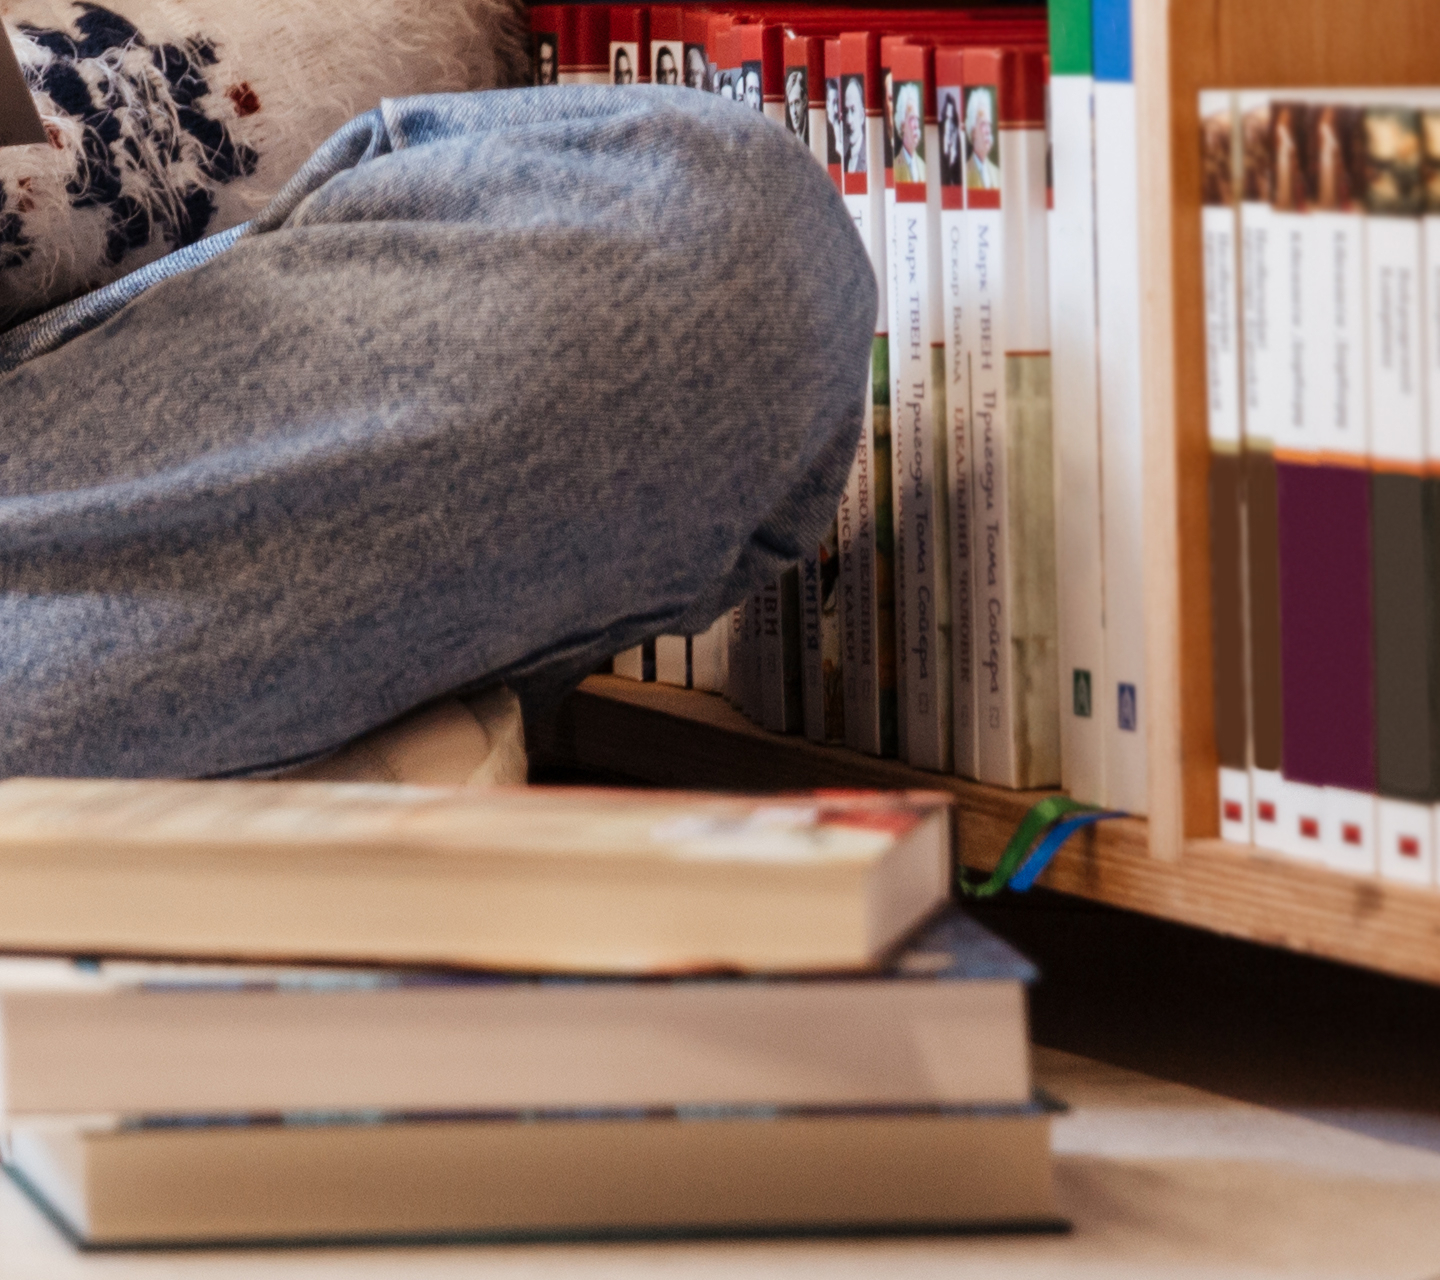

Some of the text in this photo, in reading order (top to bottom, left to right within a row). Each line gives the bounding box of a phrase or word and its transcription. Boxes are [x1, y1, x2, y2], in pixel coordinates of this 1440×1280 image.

[949, 225, 961, 298] Оскар
[905, 217, 932, 680] Марк ТВЕН Пригоди Тома Сойєра
[954, 406, 969, 560] ІДЕАЛЬНИЙ
[975, 223, 1002, 693] Марк ТВЕН Пригоди Тома Сойєра
[804, 558, 820, 651] ЖИТТЯ
[843, 584, 856, 662] КАЗКИ
[859, 546, 872, 666] ЗЕЛЕНИМ
[958, 569, 970, 683] ЧОЛОВІК
